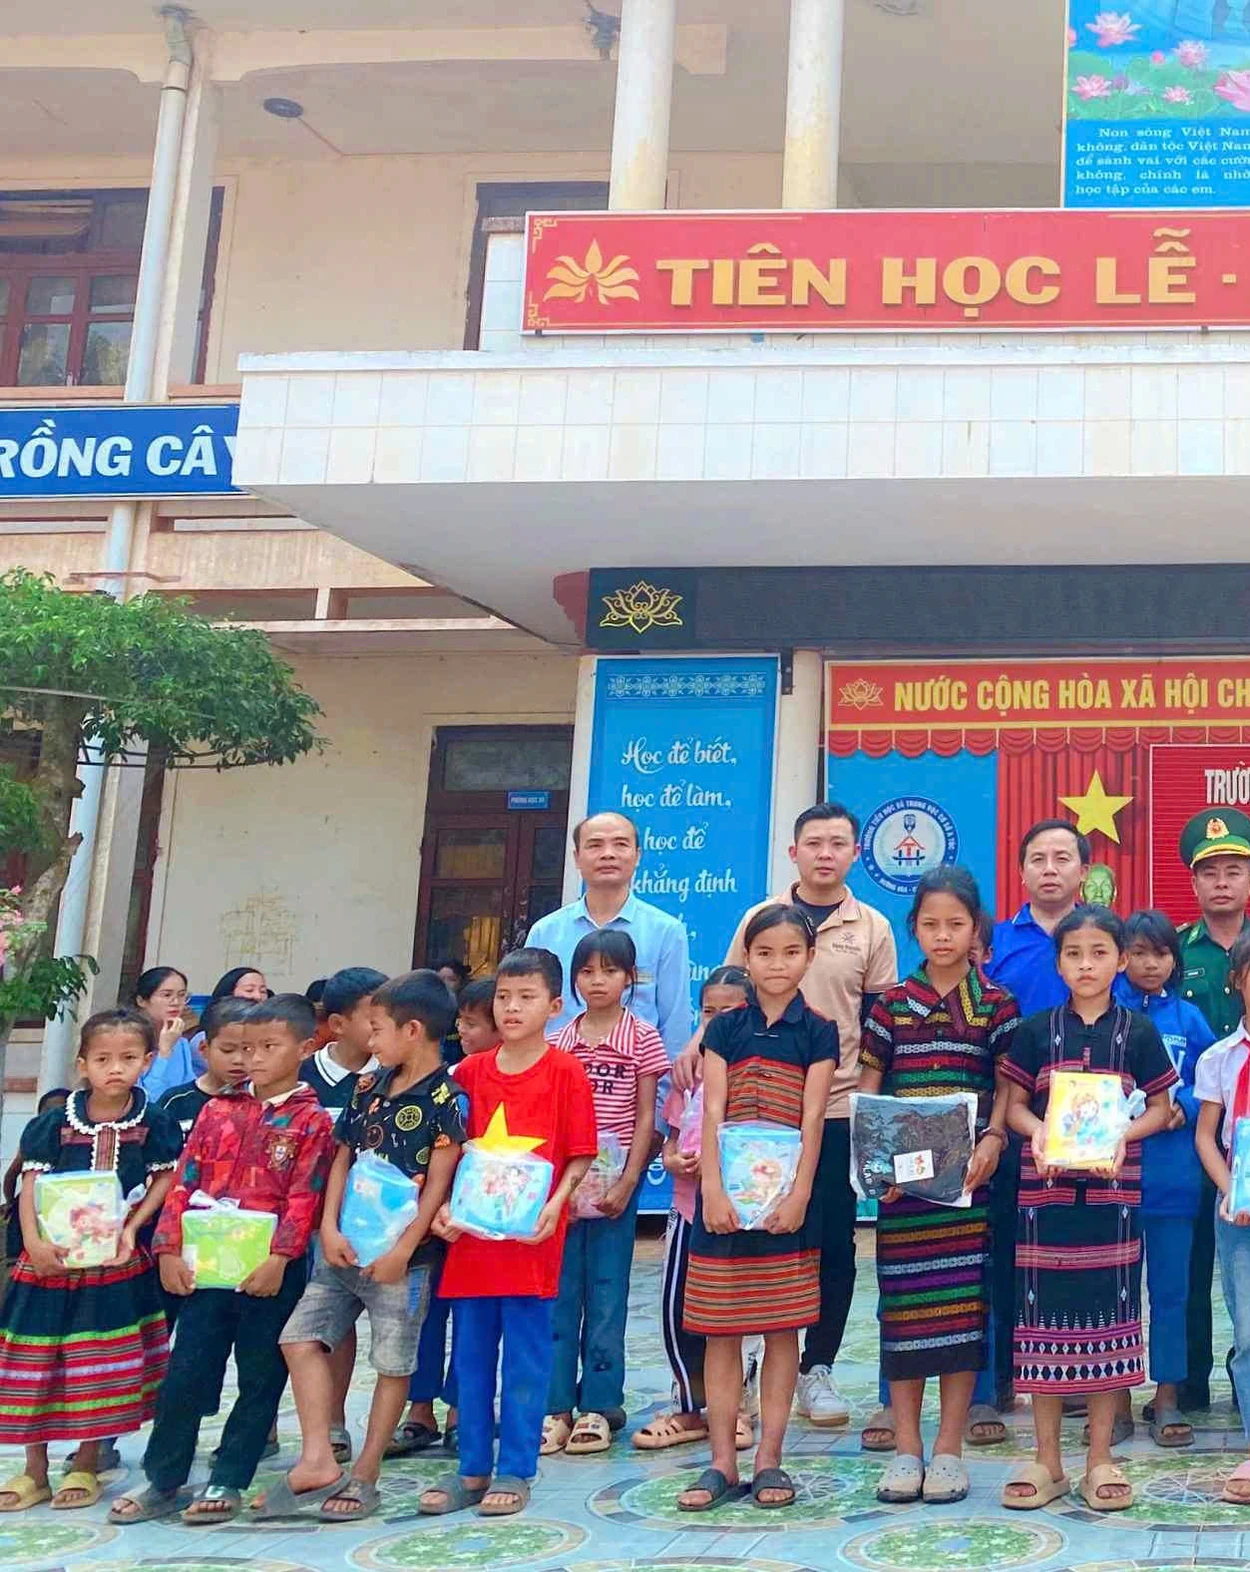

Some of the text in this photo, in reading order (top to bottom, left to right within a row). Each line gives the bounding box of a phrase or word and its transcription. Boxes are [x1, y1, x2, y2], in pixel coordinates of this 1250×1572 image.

[1099, 126, 1128, 137] Non
[1181, 126, 1211, 137] Việt
[1187, 141, 1218, 152] Việt
[655, 242, 847, 307] TIÊN
[882, 255, 1062, 318] HỌC
[1095, 227, 1196, 306] LỄ
[894, 674, 968, 712] NƯỚC
[977, 673, 1050, 717] CỘNG
[1058, 670, 1112, 710] HÒA
[1120, 673, 1156, 709] XÃ
[1165, 670, 1209, 716] HỘI
[621, 735, 737, 775] Học để biết,
[621, 783, 654, 812] học
[659, 778, 687, 807] để
[643, 822, 709, 856] học để
[631, 863, 738, 902] khẳng định
